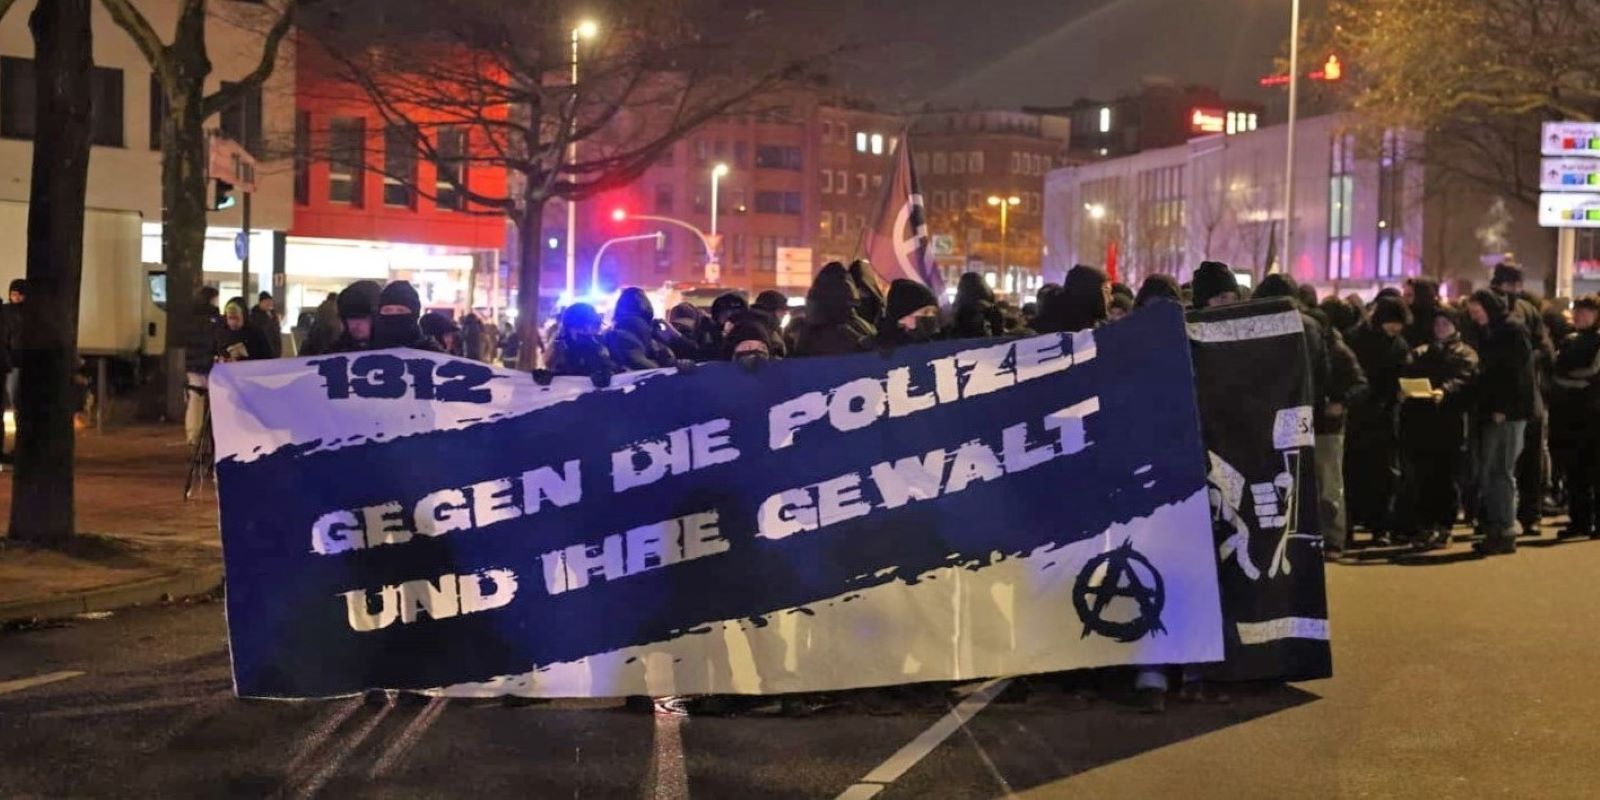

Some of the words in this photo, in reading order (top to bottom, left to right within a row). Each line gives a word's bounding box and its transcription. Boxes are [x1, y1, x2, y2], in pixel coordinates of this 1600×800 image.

[307, 354, 497, 404] 1312
[310, 459, 583, 555] GEGEN
[611, 418, 741, 493] DIE
[768, 328, 1097, 451] POLIZEI
[337, 568, 519, 632] UND
[536, 508, 731, 596] IHRE
[754, 396, 1100, 540] GEWALT
